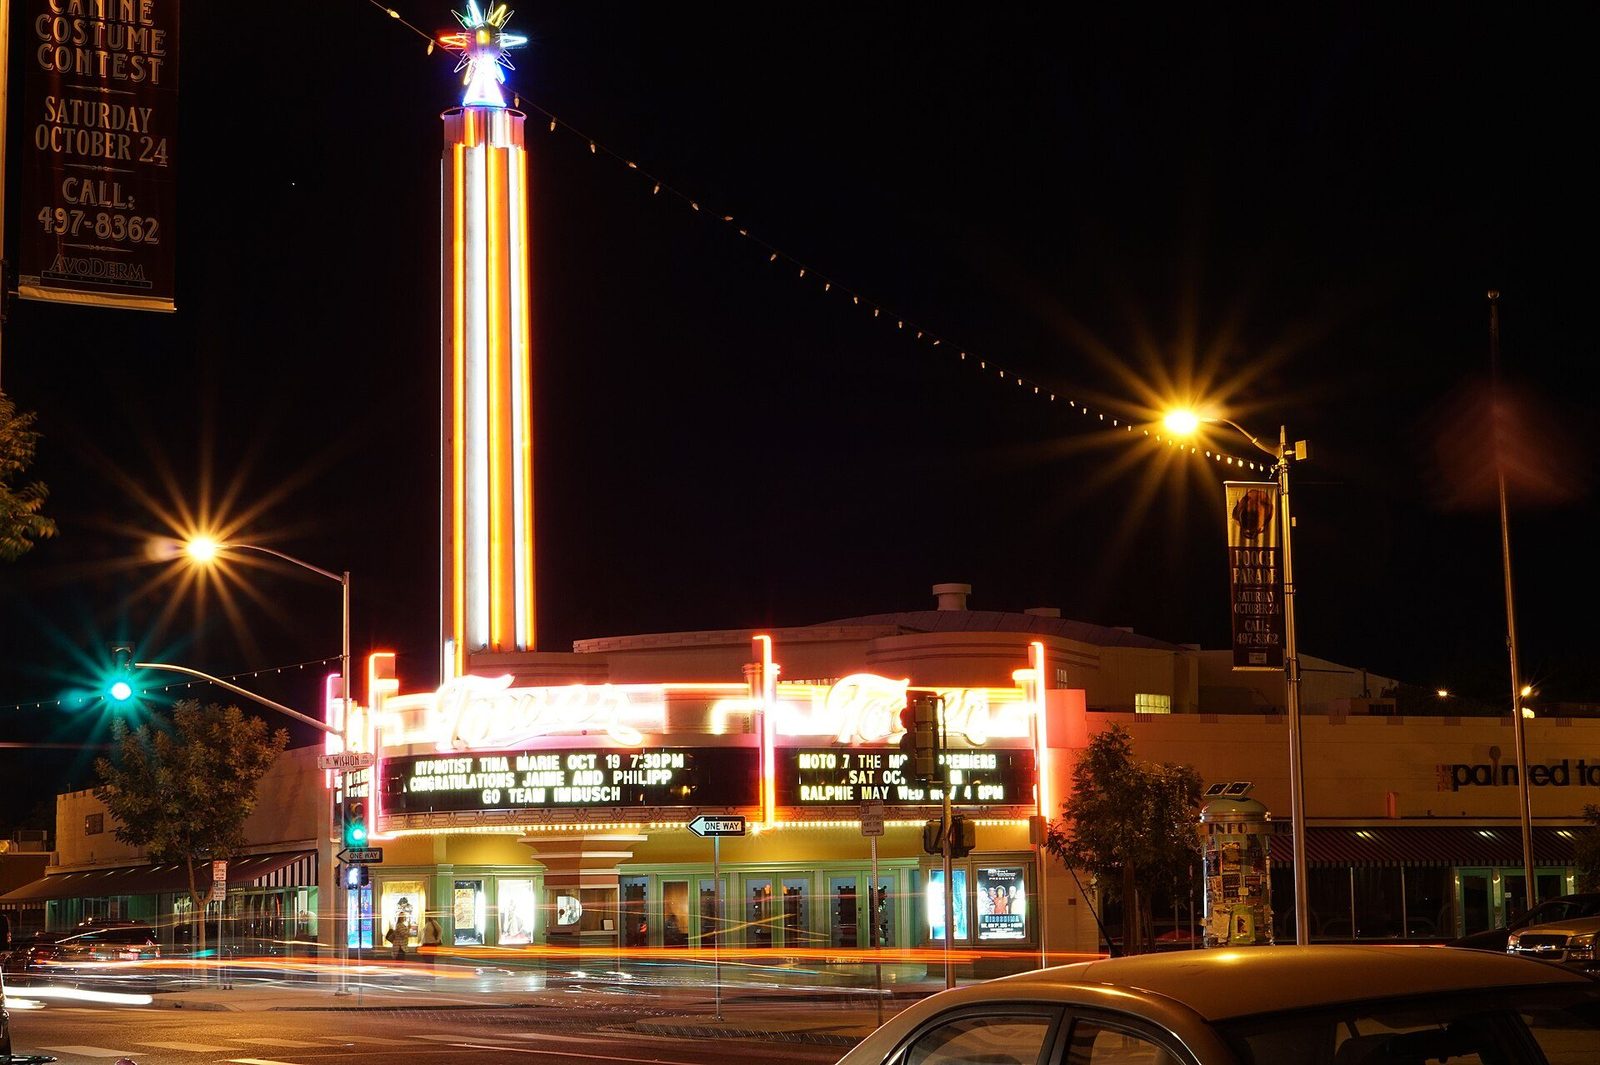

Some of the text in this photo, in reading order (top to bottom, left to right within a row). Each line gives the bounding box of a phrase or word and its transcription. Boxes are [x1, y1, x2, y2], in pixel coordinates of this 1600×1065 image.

[35, 13, 167, 57] COSTUME
[37, 43, 165, 86] CONTEST
[44, 96, 153, 134] SATURDAY
[35, 124, 169, 168] OCTOBER 24
[62, 177, 136, 210] CALL:
[37, 206, 160, 245] 497-8362
[1235, 550, 1275, 566] POOCH
[1233, 568, 1278, 585] PARADE
[1237, 591, 1275, 602] SATURDAY
[1234, 604, 1279, 614] OCTOBER 24
[332, 755, 359, 766] WISHON
[415, 753, 684, 775] HYPNOTIST TINA MARIE OCT 19 7:30PM
[799, 753, 837, 769] MOTO
[842, 754, 850, 769] 7
[858, 754, 881, 769] THE
[1453, 746, 1570, 792] pained
[409, 769, 672, 792] CONGRATULATIONS JAIME AND PHILIPP
[849, 770, 906, 784] SAT OC
[482, 786, 621, 804] GO TEAM IMBUSCH
[800, 785, 854, 800] RALPHIE
[861, 786, 889, 800] MAY
[963, 785, 972, 800] 4
[977, 785, 1004, 800] 8PM
[704, 822, 720, 830] ONE
[1208, 823, 1248, 835] INFO
